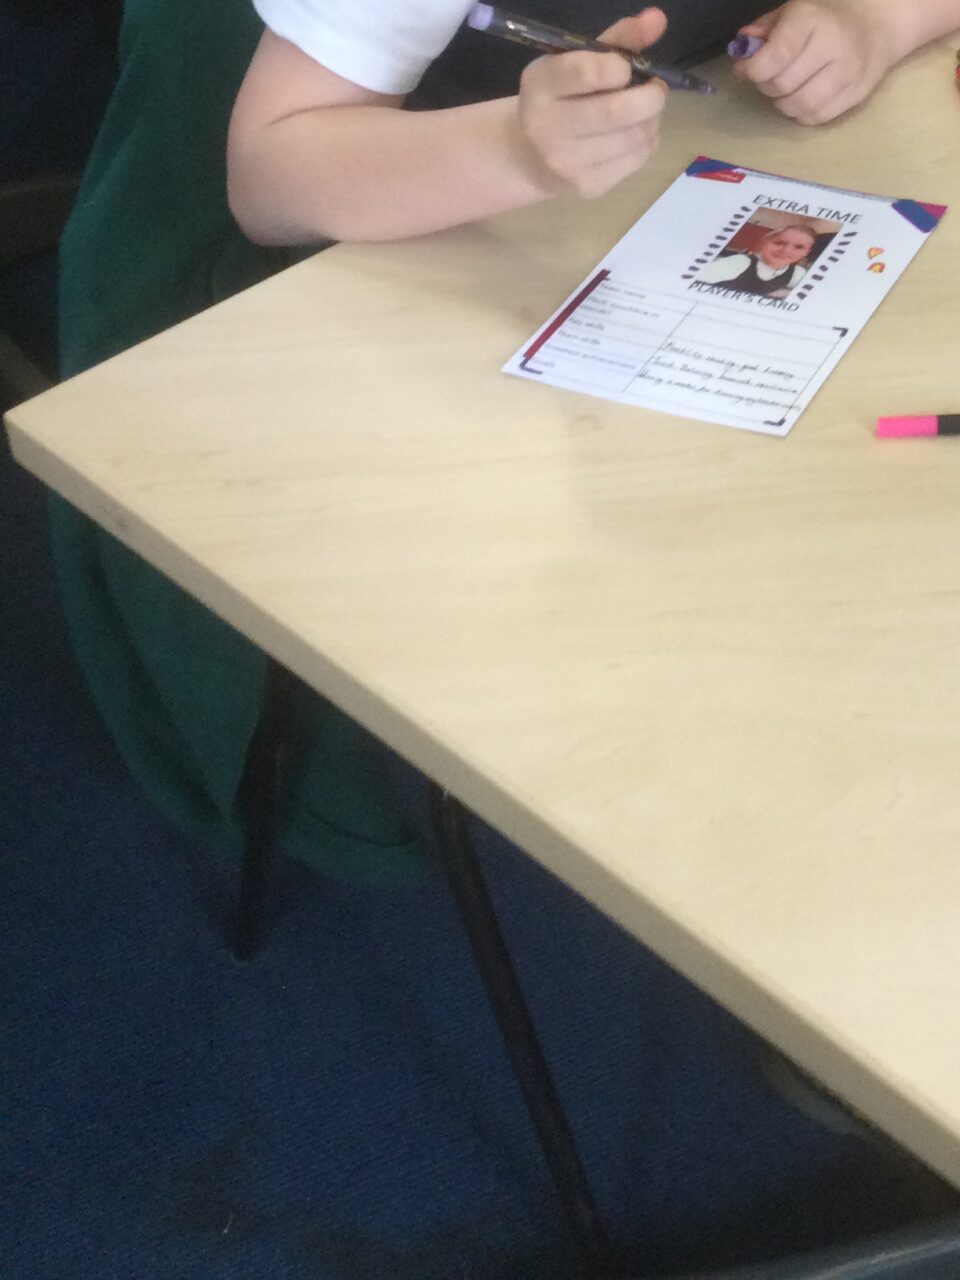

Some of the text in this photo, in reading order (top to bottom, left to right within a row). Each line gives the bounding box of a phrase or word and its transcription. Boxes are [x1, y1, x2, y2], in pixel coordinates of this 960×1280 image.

[752, 194, 863, 225] EXTRA TIME
[687, 280, 800, 313] PLAYER'S CARD
